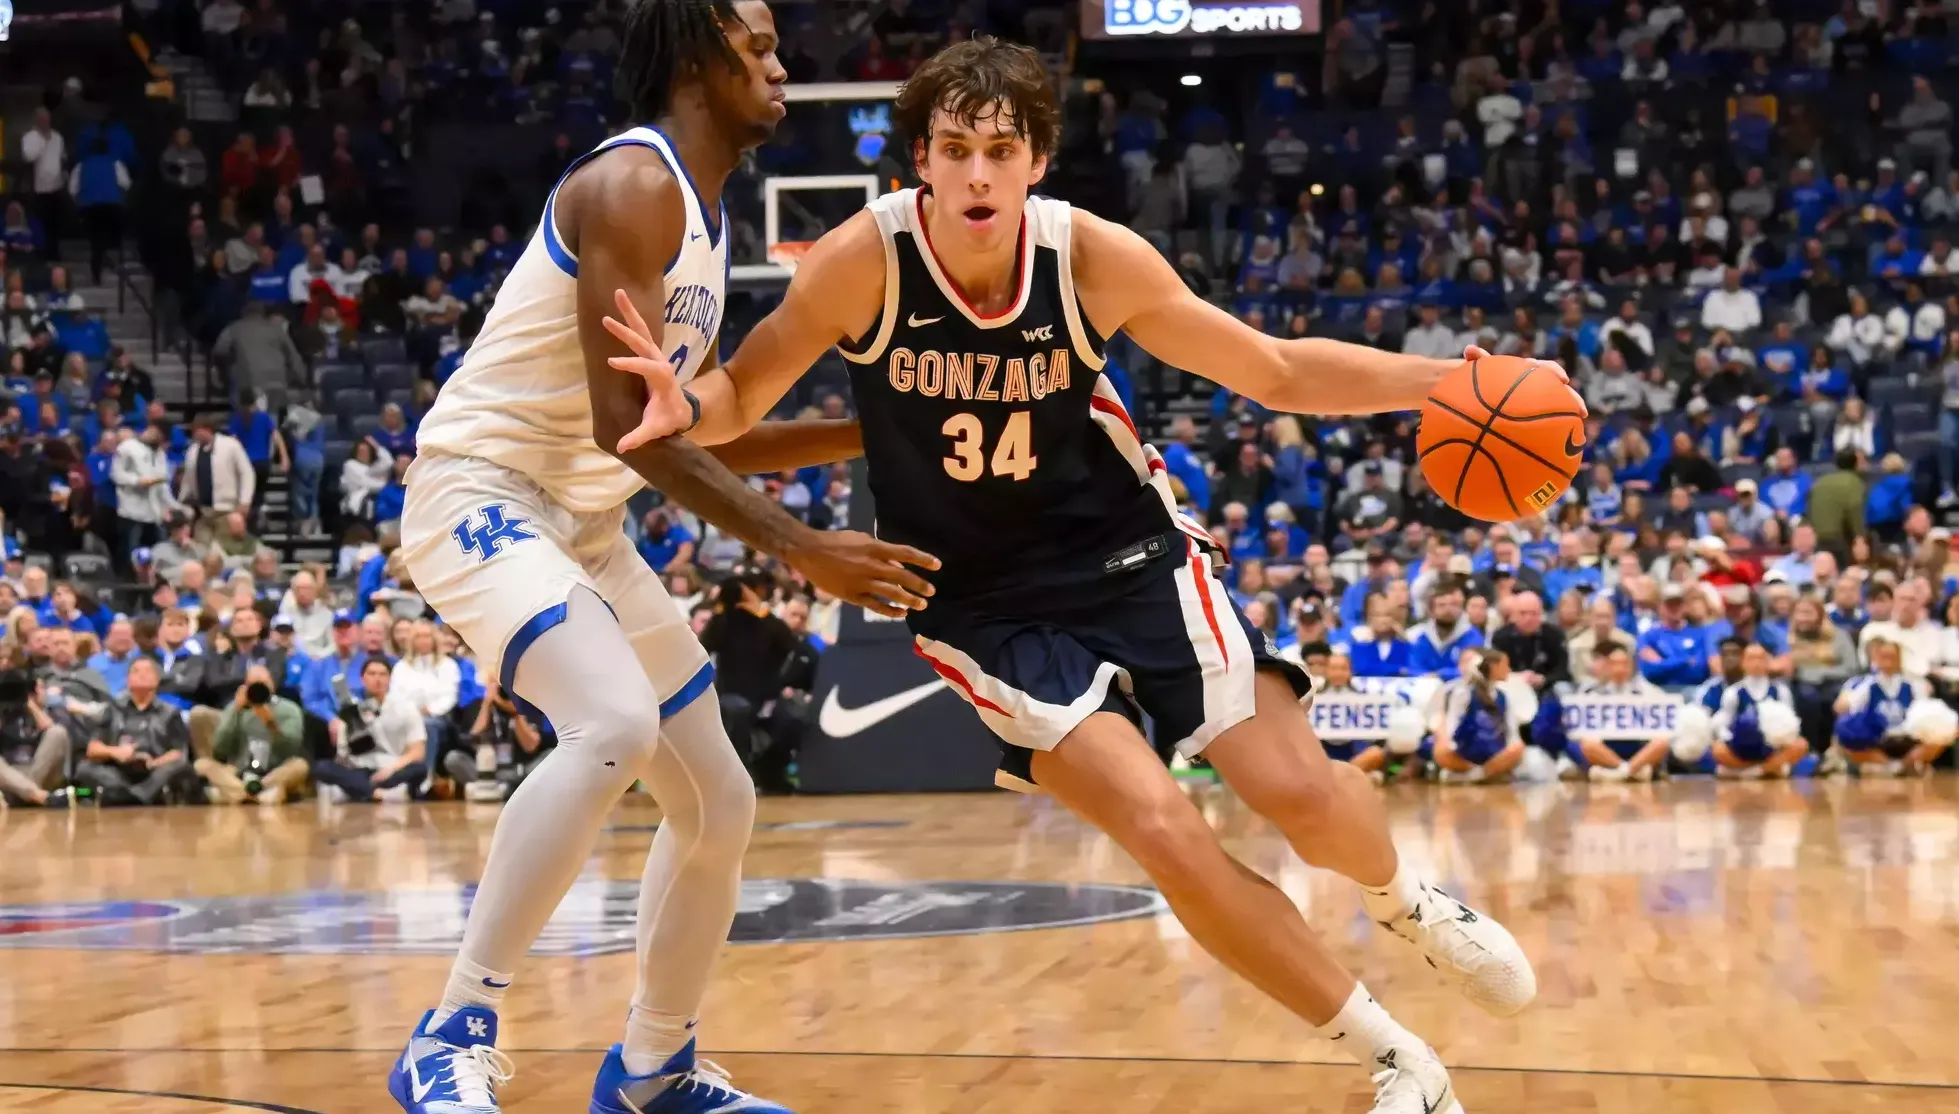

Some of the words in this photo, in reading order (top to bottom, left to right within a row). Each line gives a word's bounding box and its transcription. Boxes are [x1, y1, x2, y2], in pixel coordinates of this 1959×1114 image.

[1191, 6, 1302, 32] SPORTS
[1021, 324, 1054, 343] WCC
[889, 347, 1070, 402] GONZAGA
[941, 410, 1037, 482] 34
[1148, 542, 1159, 552] 48
[1312, 704, 1390, 729] FENSE
[1563, 704, 1677, 730] DEFENSE
